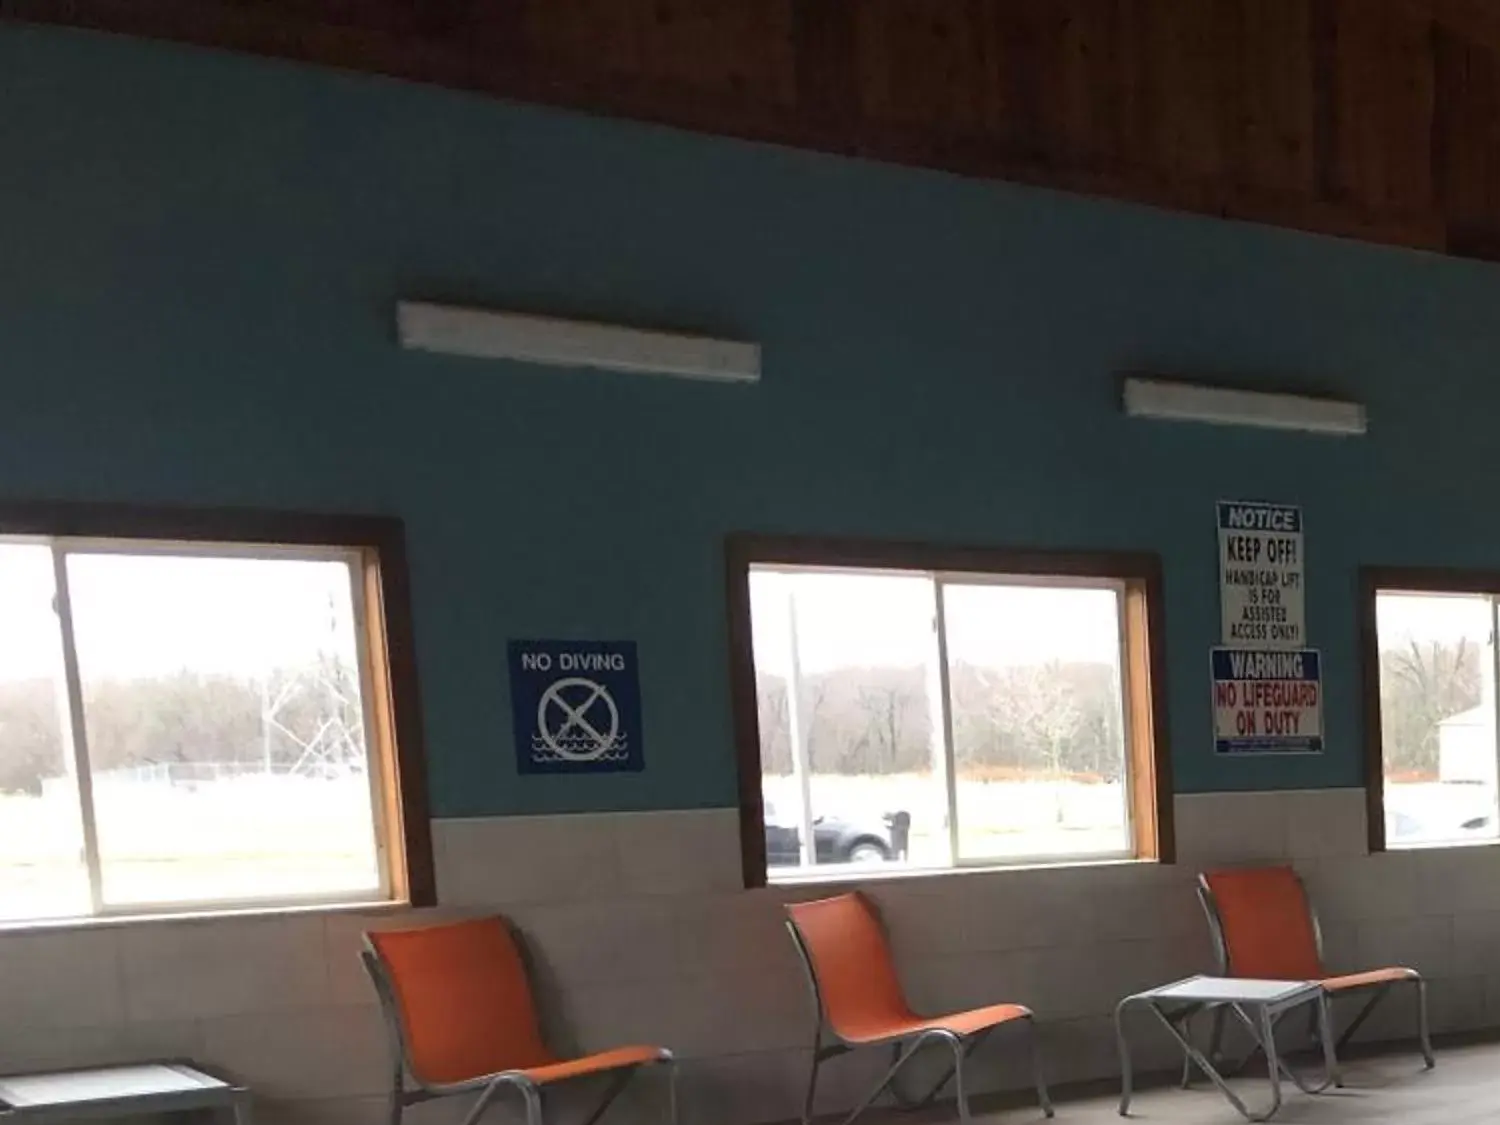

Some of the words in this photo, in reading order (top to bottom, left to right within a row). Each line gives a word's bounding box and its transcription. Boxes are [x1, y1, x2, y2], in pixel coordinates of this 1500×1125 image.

[1228, 507, 1295, 529] NOTICE
[1227, 535, 1261, 562] KEEP
[1266, 538, 1297, 563] OFF!
[1225, 568, 1278, 586] HANDICAP
[1281, 571, 1300, 588] LIFT
[1249, 587, 1259, 604] IS
[1262, 588, 1281, 604] FOR
[1242, 606, 1287, 622] ASSISTED
[1230, 623, 1267, 640] ACCESS
[521, 653, 551, 671] NO
[559, 654, 625, 671] DIVING
[1230, 652, 1304, 679] WARNING
[1216, 682, 1237, 708] NO
[1242, 682, 1317, 707] LIFEGUARD
[1236, 710, 1256, 736] ON
[1264, 711, 1300, 735] DUTY
